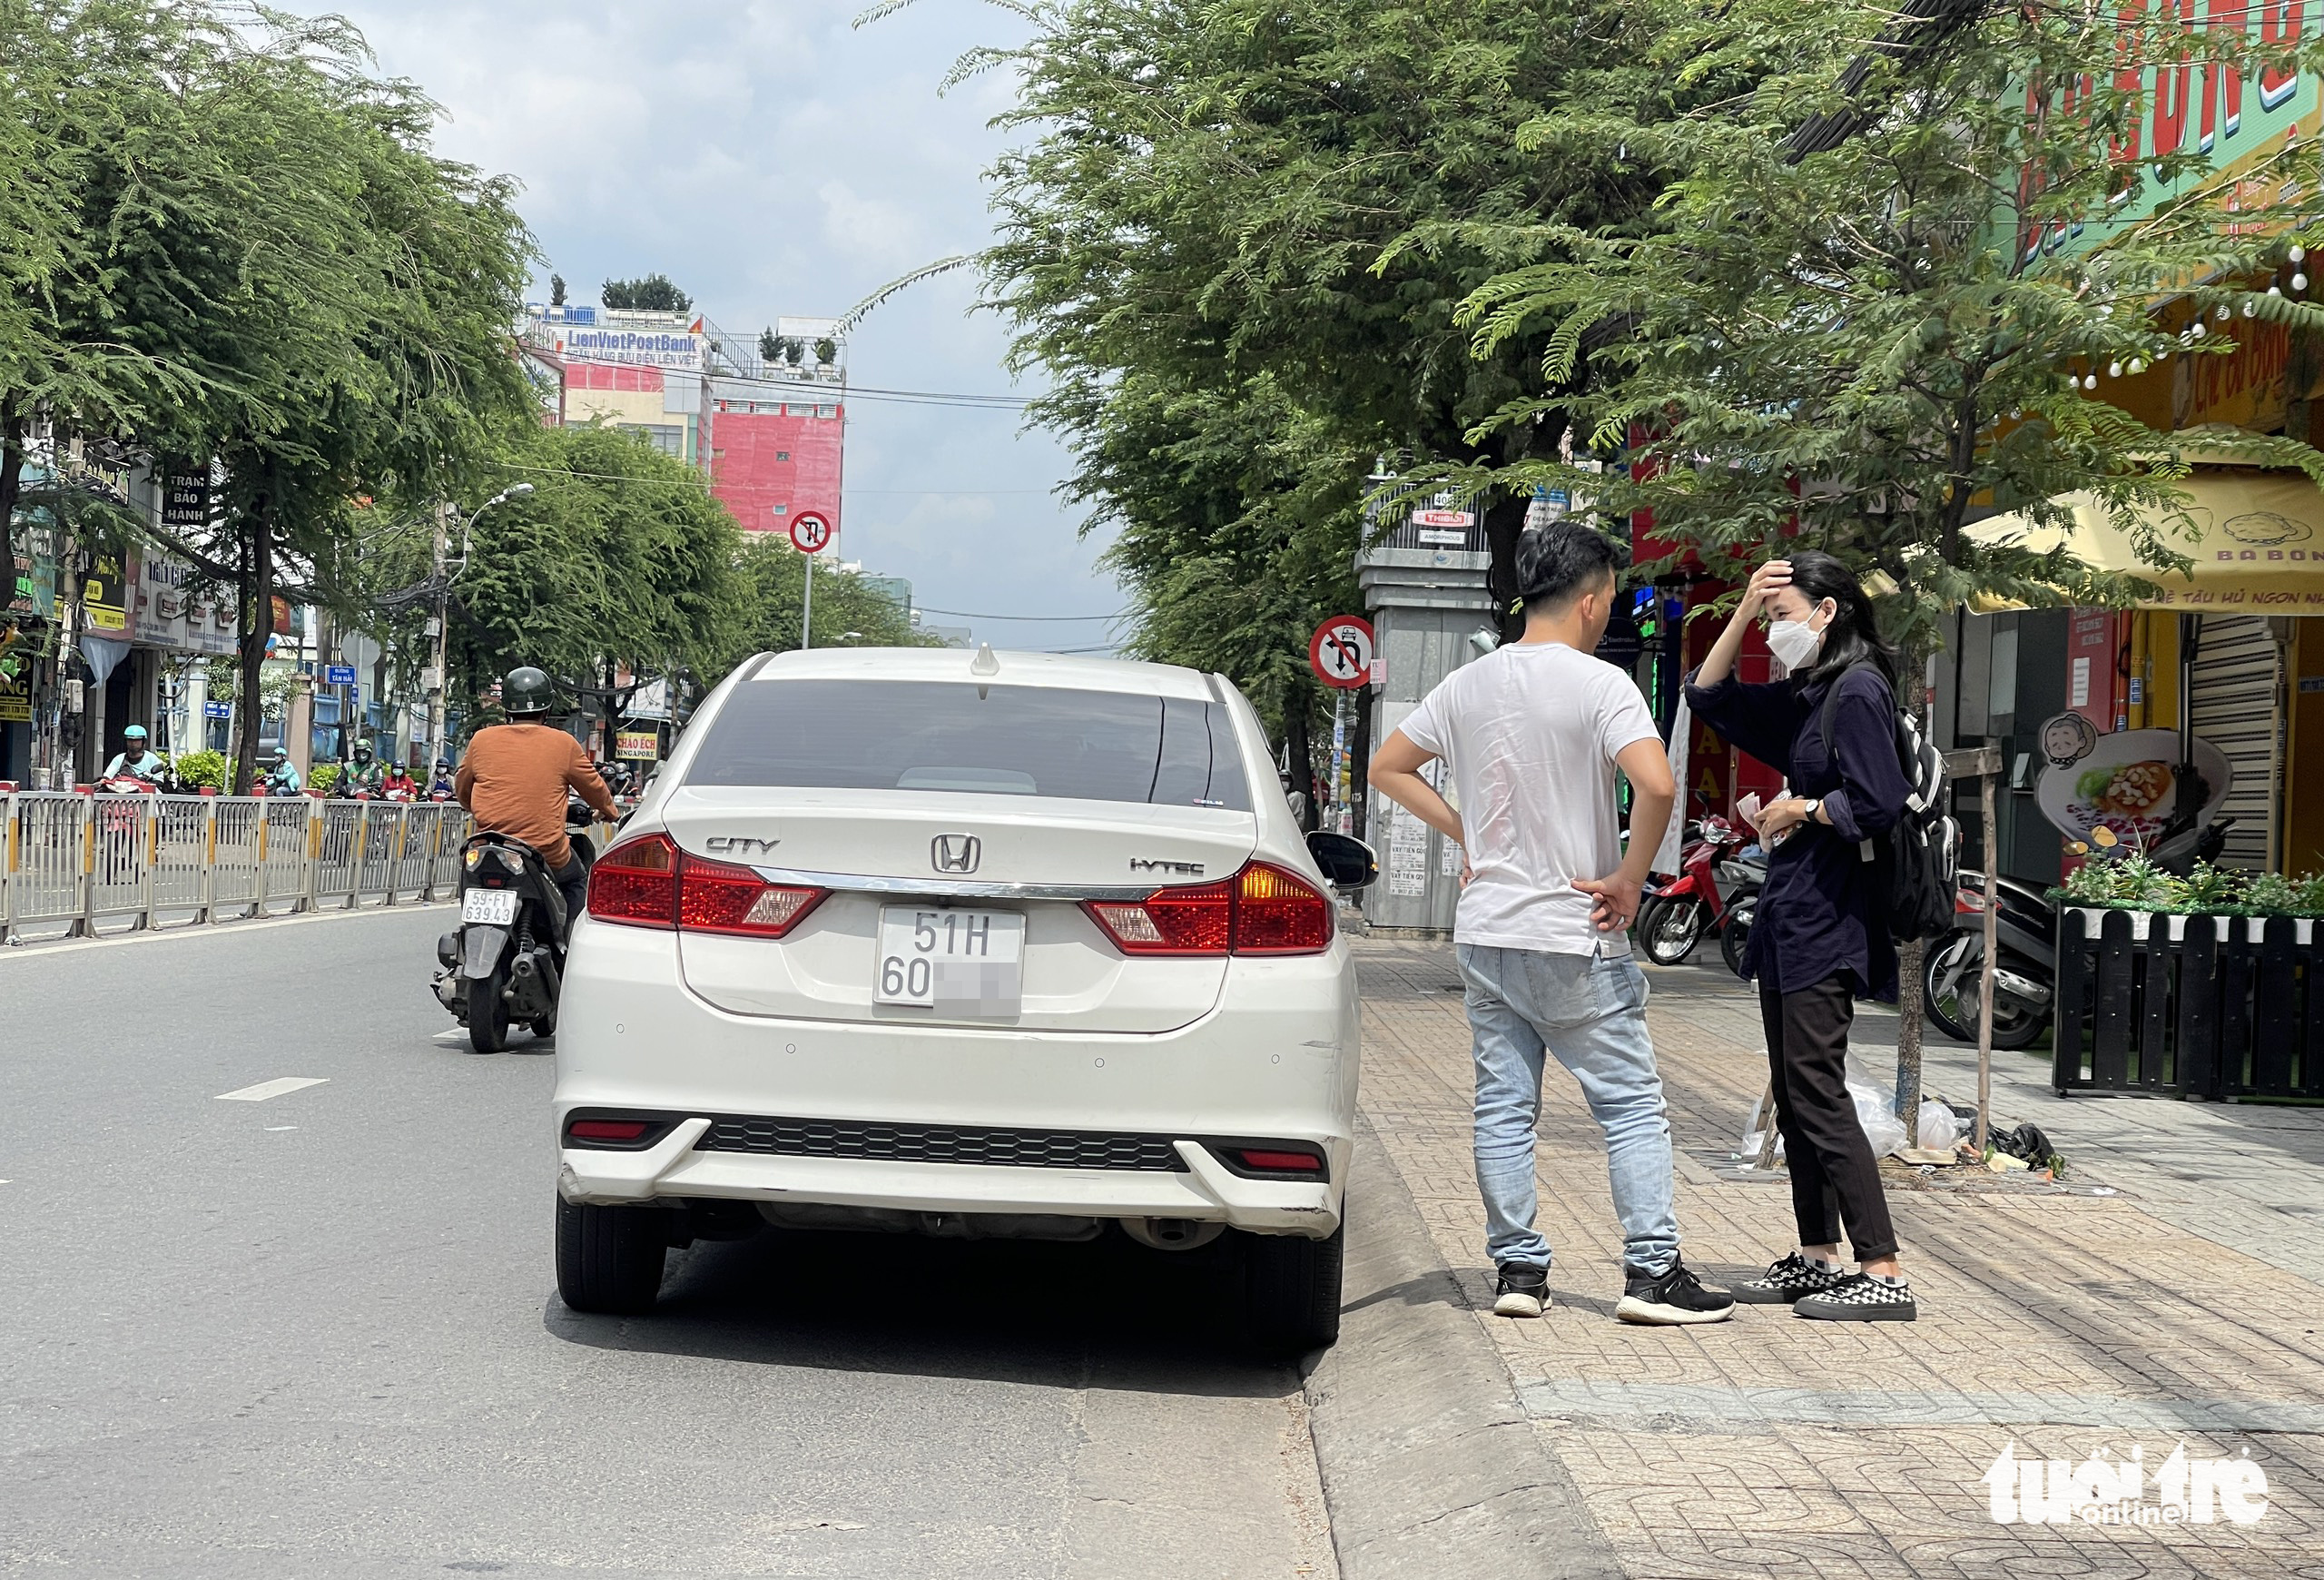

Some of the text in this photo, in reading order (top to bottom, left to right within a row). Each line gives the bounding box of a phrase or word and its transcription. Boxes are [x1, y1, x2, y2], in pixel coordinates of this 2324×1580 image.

[568, 330, 696, 352] LienVietPostBank
[170, 476, 205, 489] TRẠM
[174, 489, 198, 504] BẢO
[168, 507, 203, 521] HÀNH
[2251, 592, 2299, 604] NGON
[617, 749, 655, 758] SINGAPORE
[706, 837, 781, 855] CITY
[473, 892, 507, 907] 59-F1
[466, 906, 510, 922] 639.43
[914, 912, 990, 956] 51H
